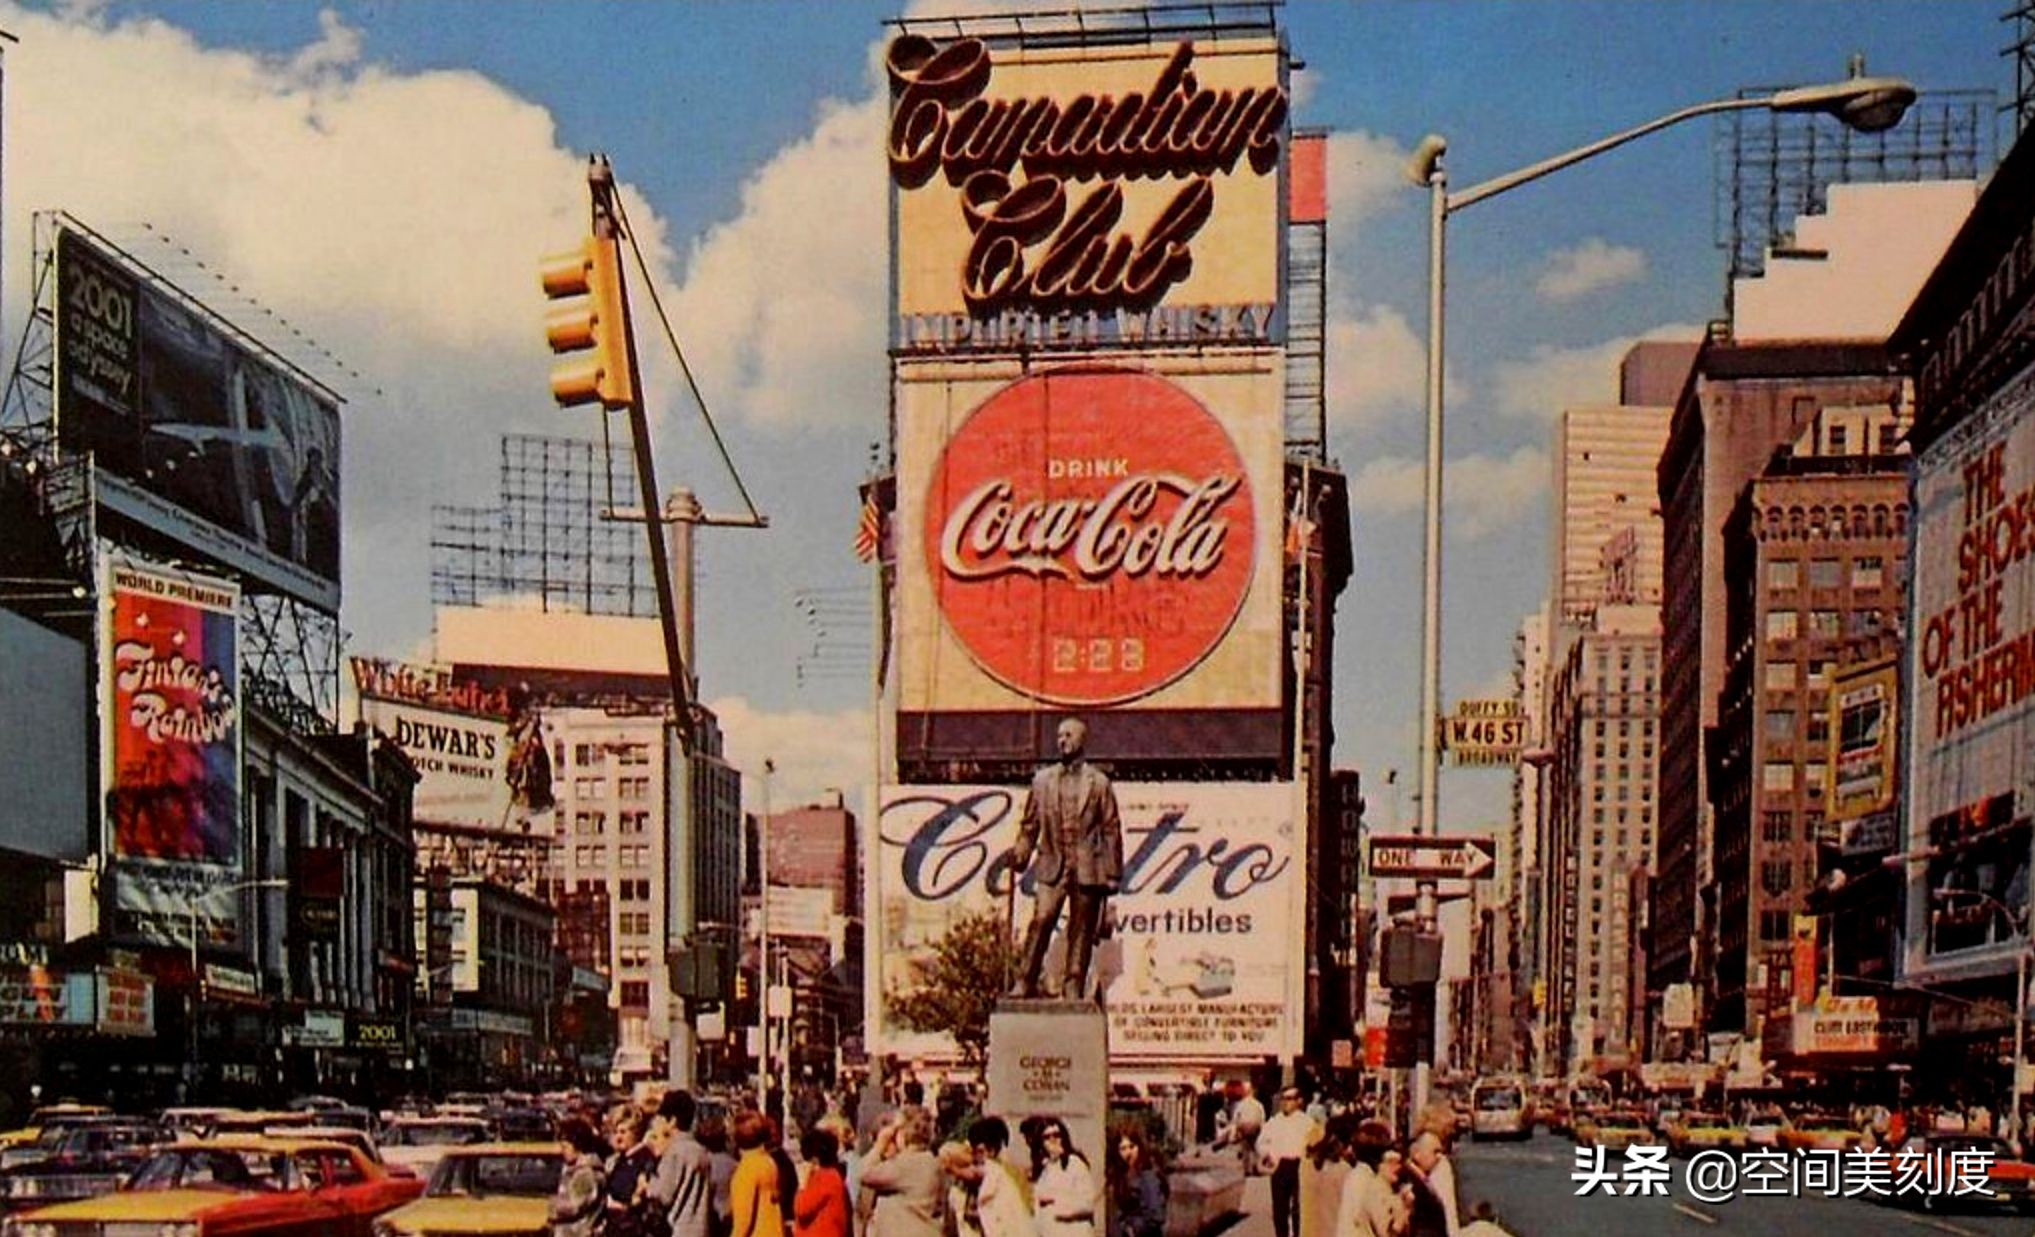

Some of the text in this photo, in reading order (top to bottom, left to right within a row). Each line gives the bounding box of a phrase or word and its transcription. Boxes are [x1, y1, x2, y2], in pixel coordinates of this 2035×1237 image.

[888, 34, 1289, 190] Canadian
[962, 169, 1215, 320] Club
[69, 263, 133, 338] 2001
[1116, 301, 1275, 343] WHISKY
[1048, 458, 1129, 478] DRINK
[1962, 439, 2007, 527] THE
[115, 572, 232, 609] WORLD PREMIERE
[1923, 580, 2004, 679] OF THE
[1936, 629, 2035, 739] FISHERM
[130, 692, 236, 744] Rainbow
[1460, 701, 1500, 716] DUFFY
[396, 716, 496, 761] DEWAR'S
[1501, 721, 1524, 744] ST
[412, 757, 494, 779] OTCH WHISKY
[1459, 751, 1518, 765] BROADWAY
[880, 789, 1290, 901] Catro
[1378, 850, 1477, 866] ONE WAY
[359, 1025, 396, 1040] 2001
